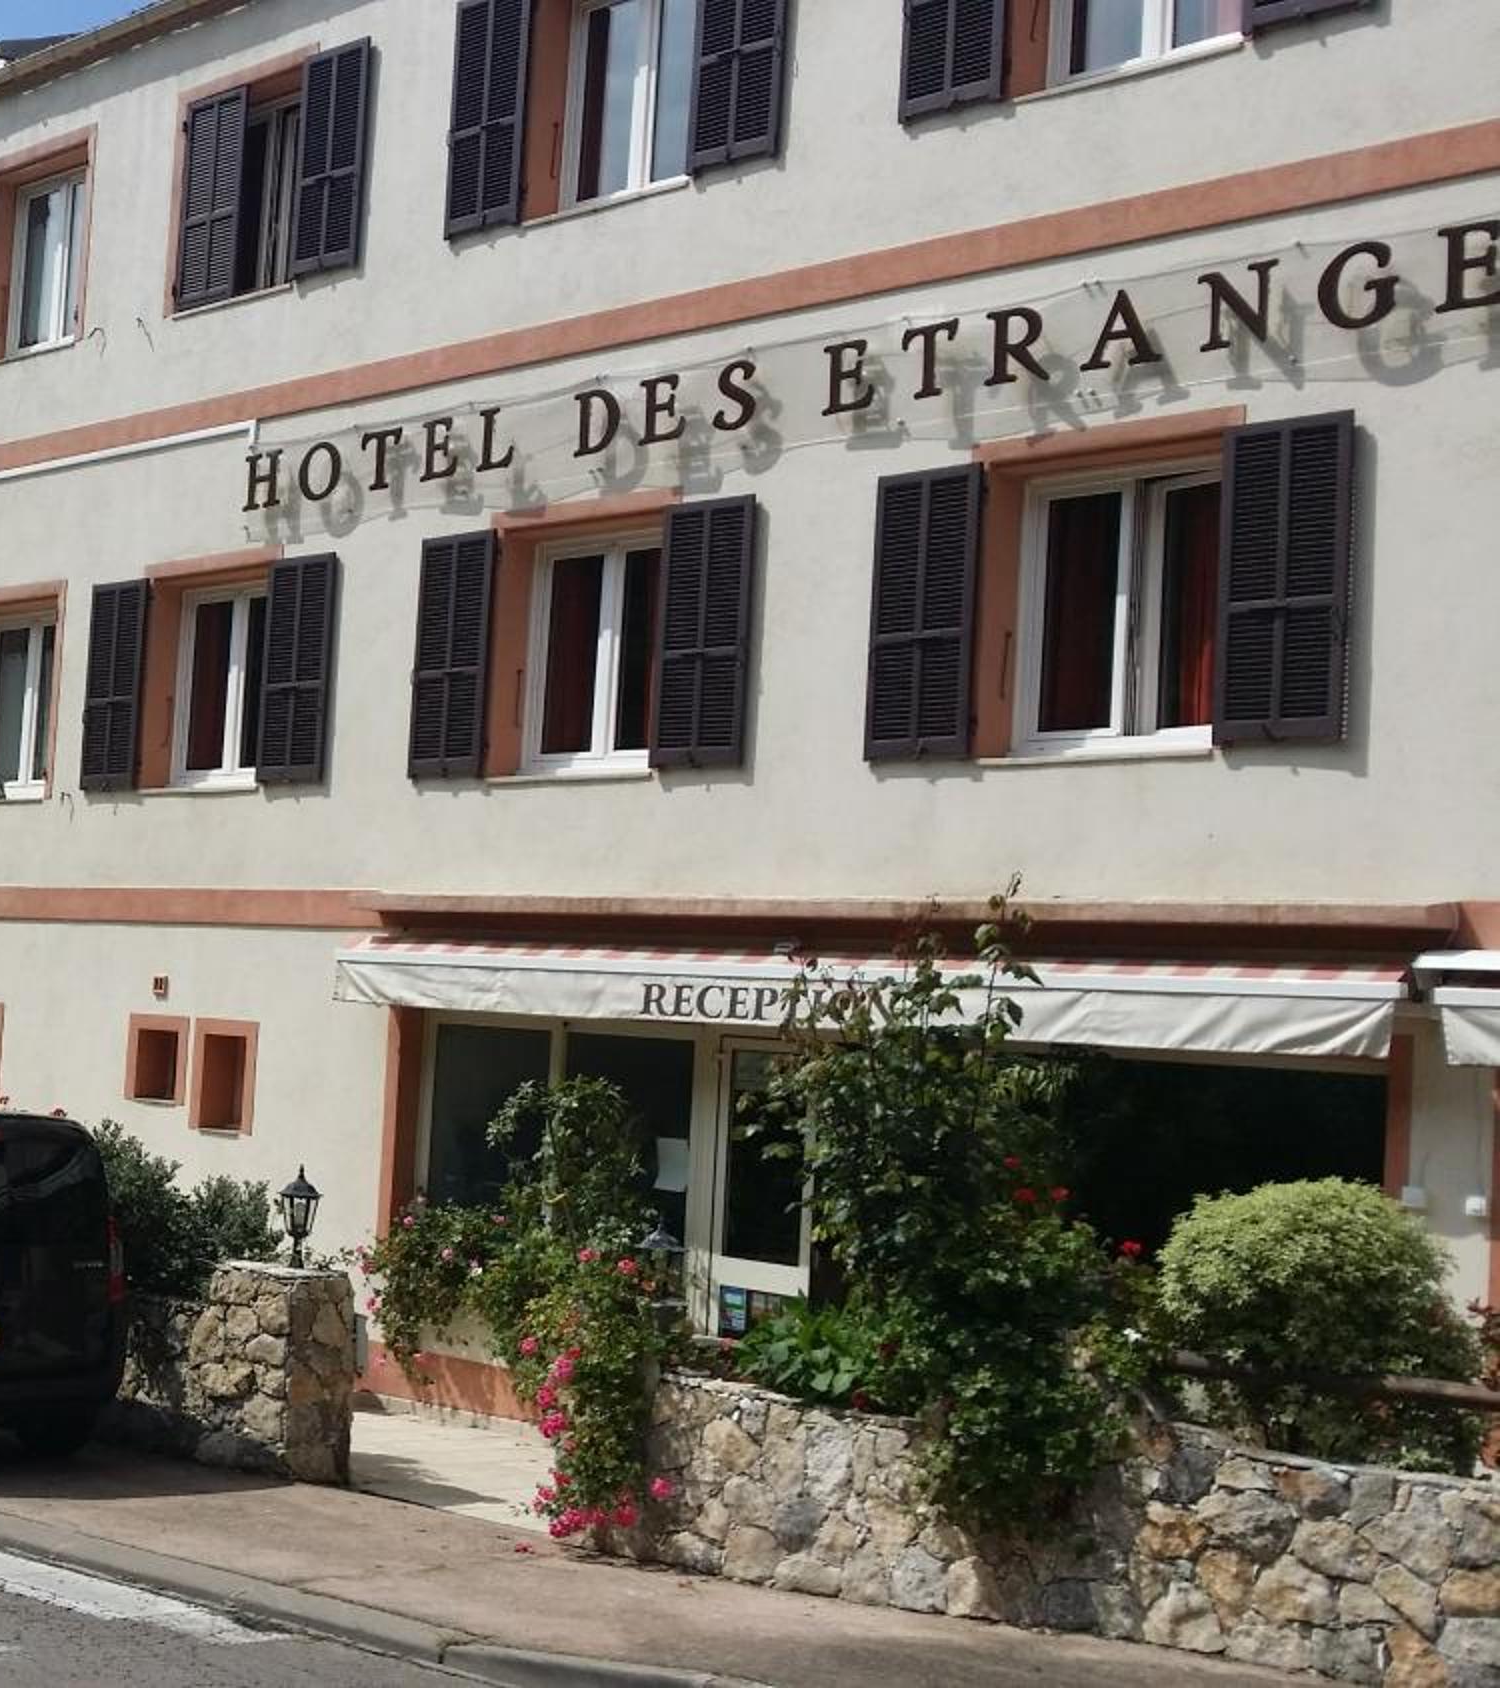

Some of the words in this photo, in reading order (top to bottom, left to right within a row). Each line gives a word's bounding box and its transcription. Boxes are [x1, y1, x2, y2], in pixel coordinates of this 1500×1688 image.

[242, 408, 514, 512] HOTEL
[573, 361, 757, 458] DES
[822, 219, 1500, 417] ETRANGE
